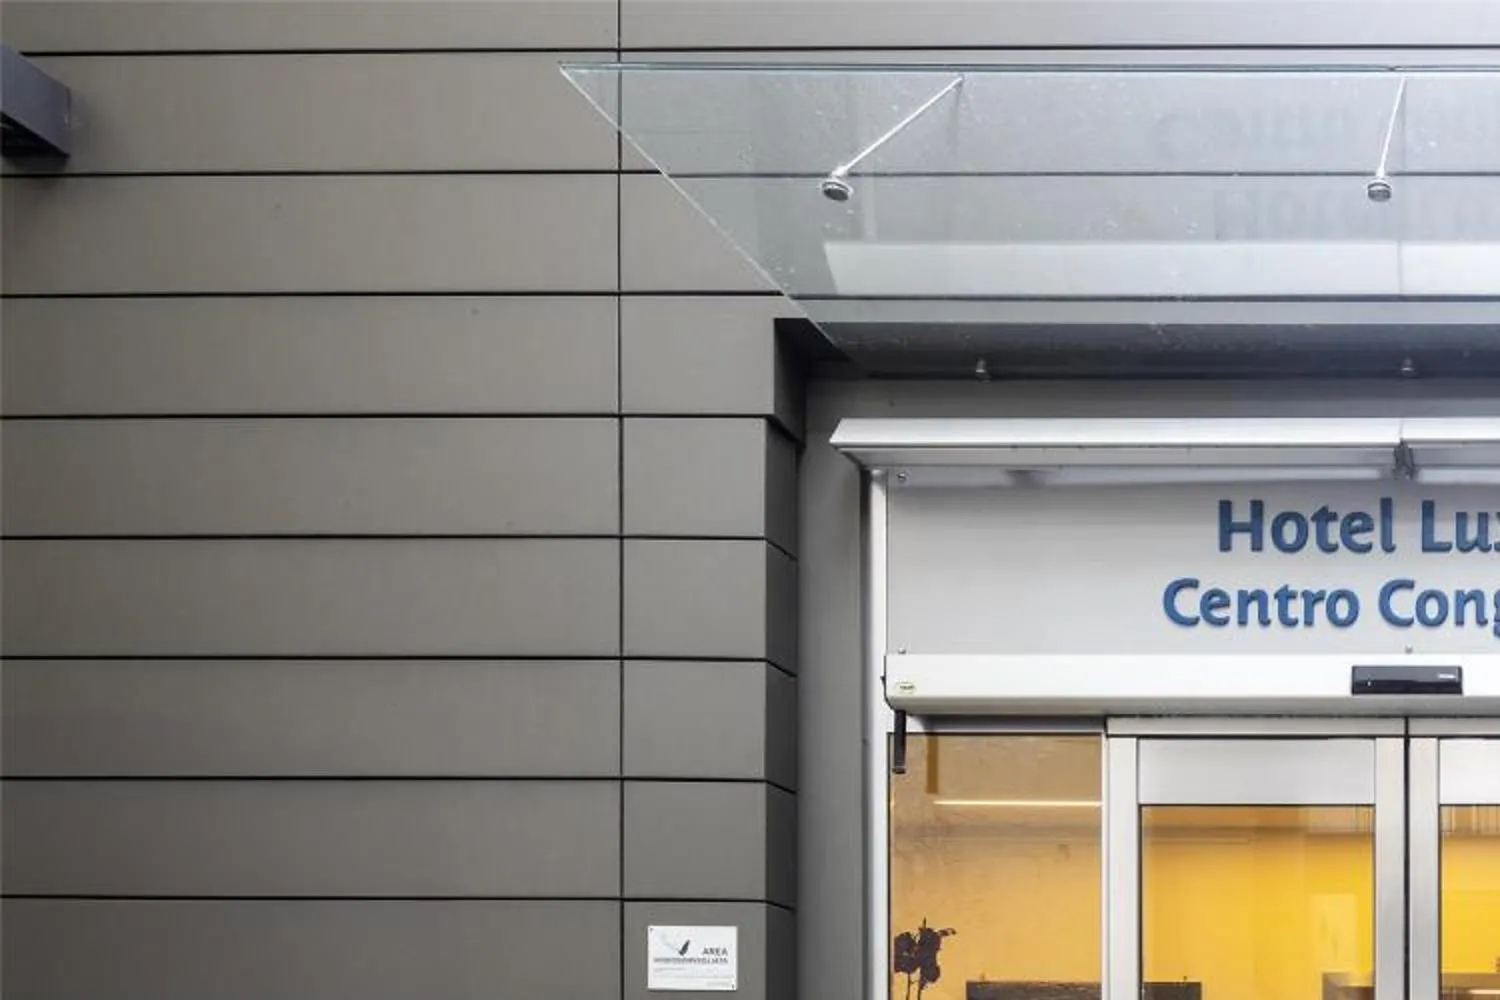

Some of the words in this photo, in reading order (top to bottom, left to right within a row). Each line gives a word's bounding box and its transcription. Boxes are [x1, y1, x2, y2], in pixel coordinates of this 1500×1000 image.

[1217, 497, 1396, 554] Hotel
[1162, 577, 1360, 629] Centro
[702, 947, 729, 956] AREA
